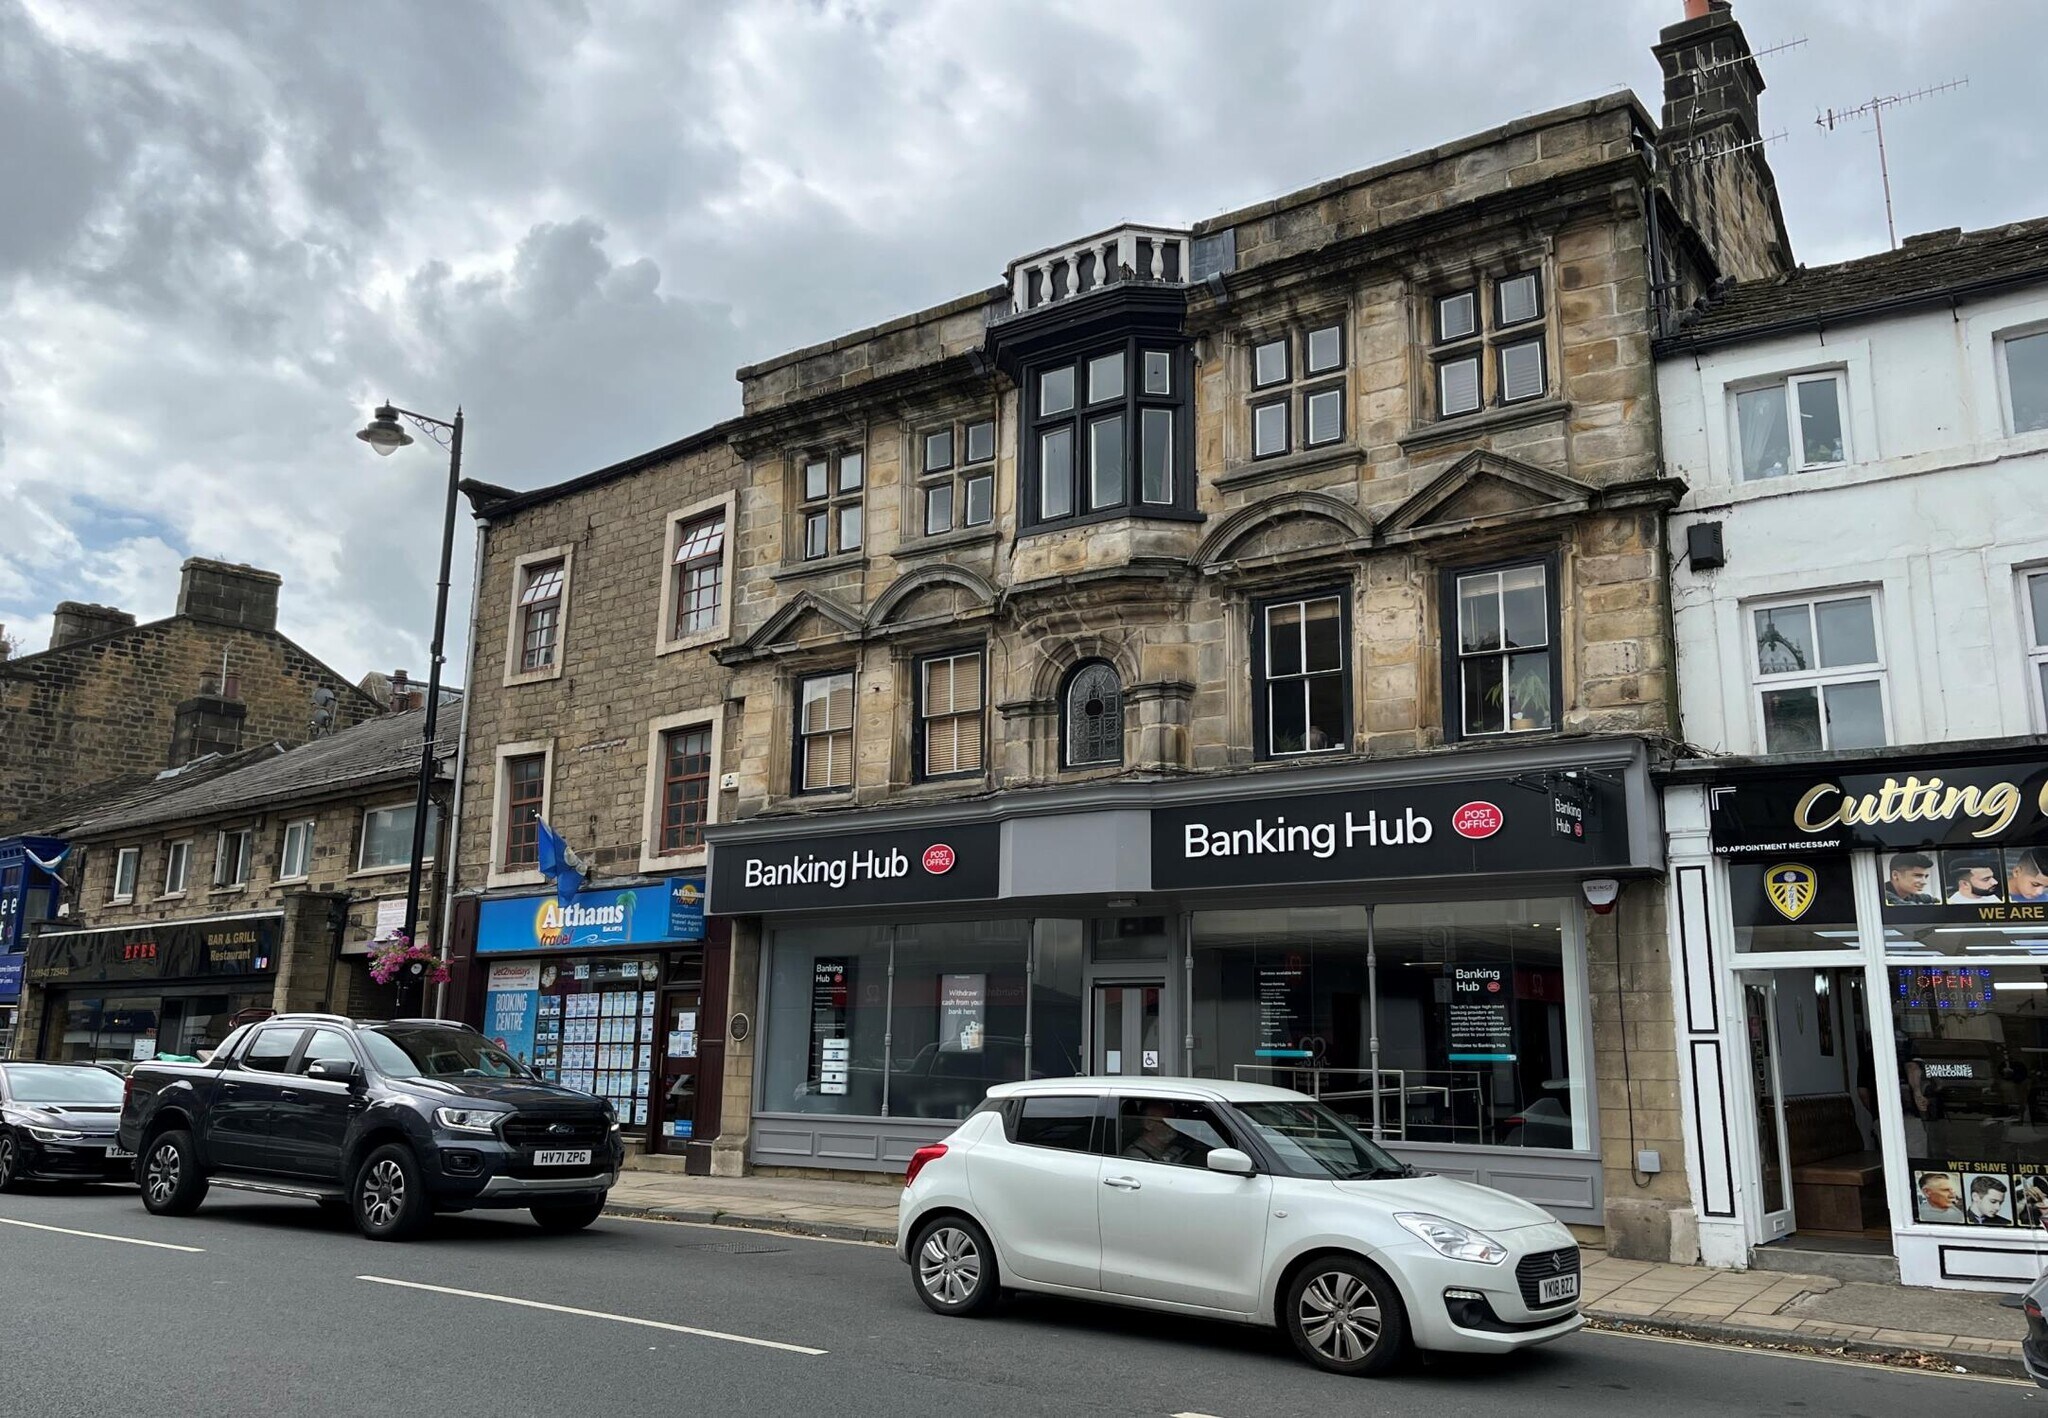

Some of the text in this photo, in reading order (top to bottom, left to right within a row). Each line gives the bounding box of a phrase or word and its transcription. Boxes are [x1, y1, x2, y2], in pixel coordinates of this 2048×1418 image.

[1464, 808, 1491, 819] POST
[1554, 798, 1582, 821] Banking
[1793, 776, 2021, 838] Cutting
[1458, 817, 1497, 830] OFFICE
[1555, 817, 1571, 834] Hub
[1184, 807, 1433, 859] Banking Hub
[1729, 843, 1787, 853] APPOINTMENT
[1788, 840, 1840, 849] NECESSARY
[930, 850, 948, 859] POST
[744, 847, 908, 888] Banking Hub
[926, 857, 950, 866] OFFICE
[541, 902, 624, 929] Althams
[1979, 906, 2045, 919] WE ARE
[208, 930, 256, 945] BAR & GRILL
[540, 929, 575, 946] travel
[125, 943, 157, 959] EFES
[210, 948, 251, 962] Restaurant
[816, 964, 843, 974] Banking
[1455, 968, 1500, 980] Banking
[815, 974, 830, 983] Hub
[1917, 975, 1973, 988] OPEN
[1456, 981, 1480, 992] Hub
[495, 993, 527, 1011] BOOKING
[496, 1012, 524, 1031] CENTRE
[541, 1151, 586, 1164] HV71 ZPG
[1947, 1161, 1970, 1171] WET
[1974, 1162, 2007, 1172] SHAVE
[2019, 1164, 2039, 1174] HOT
[1543, 1277, 1574, 1298] YK18 BZZ
